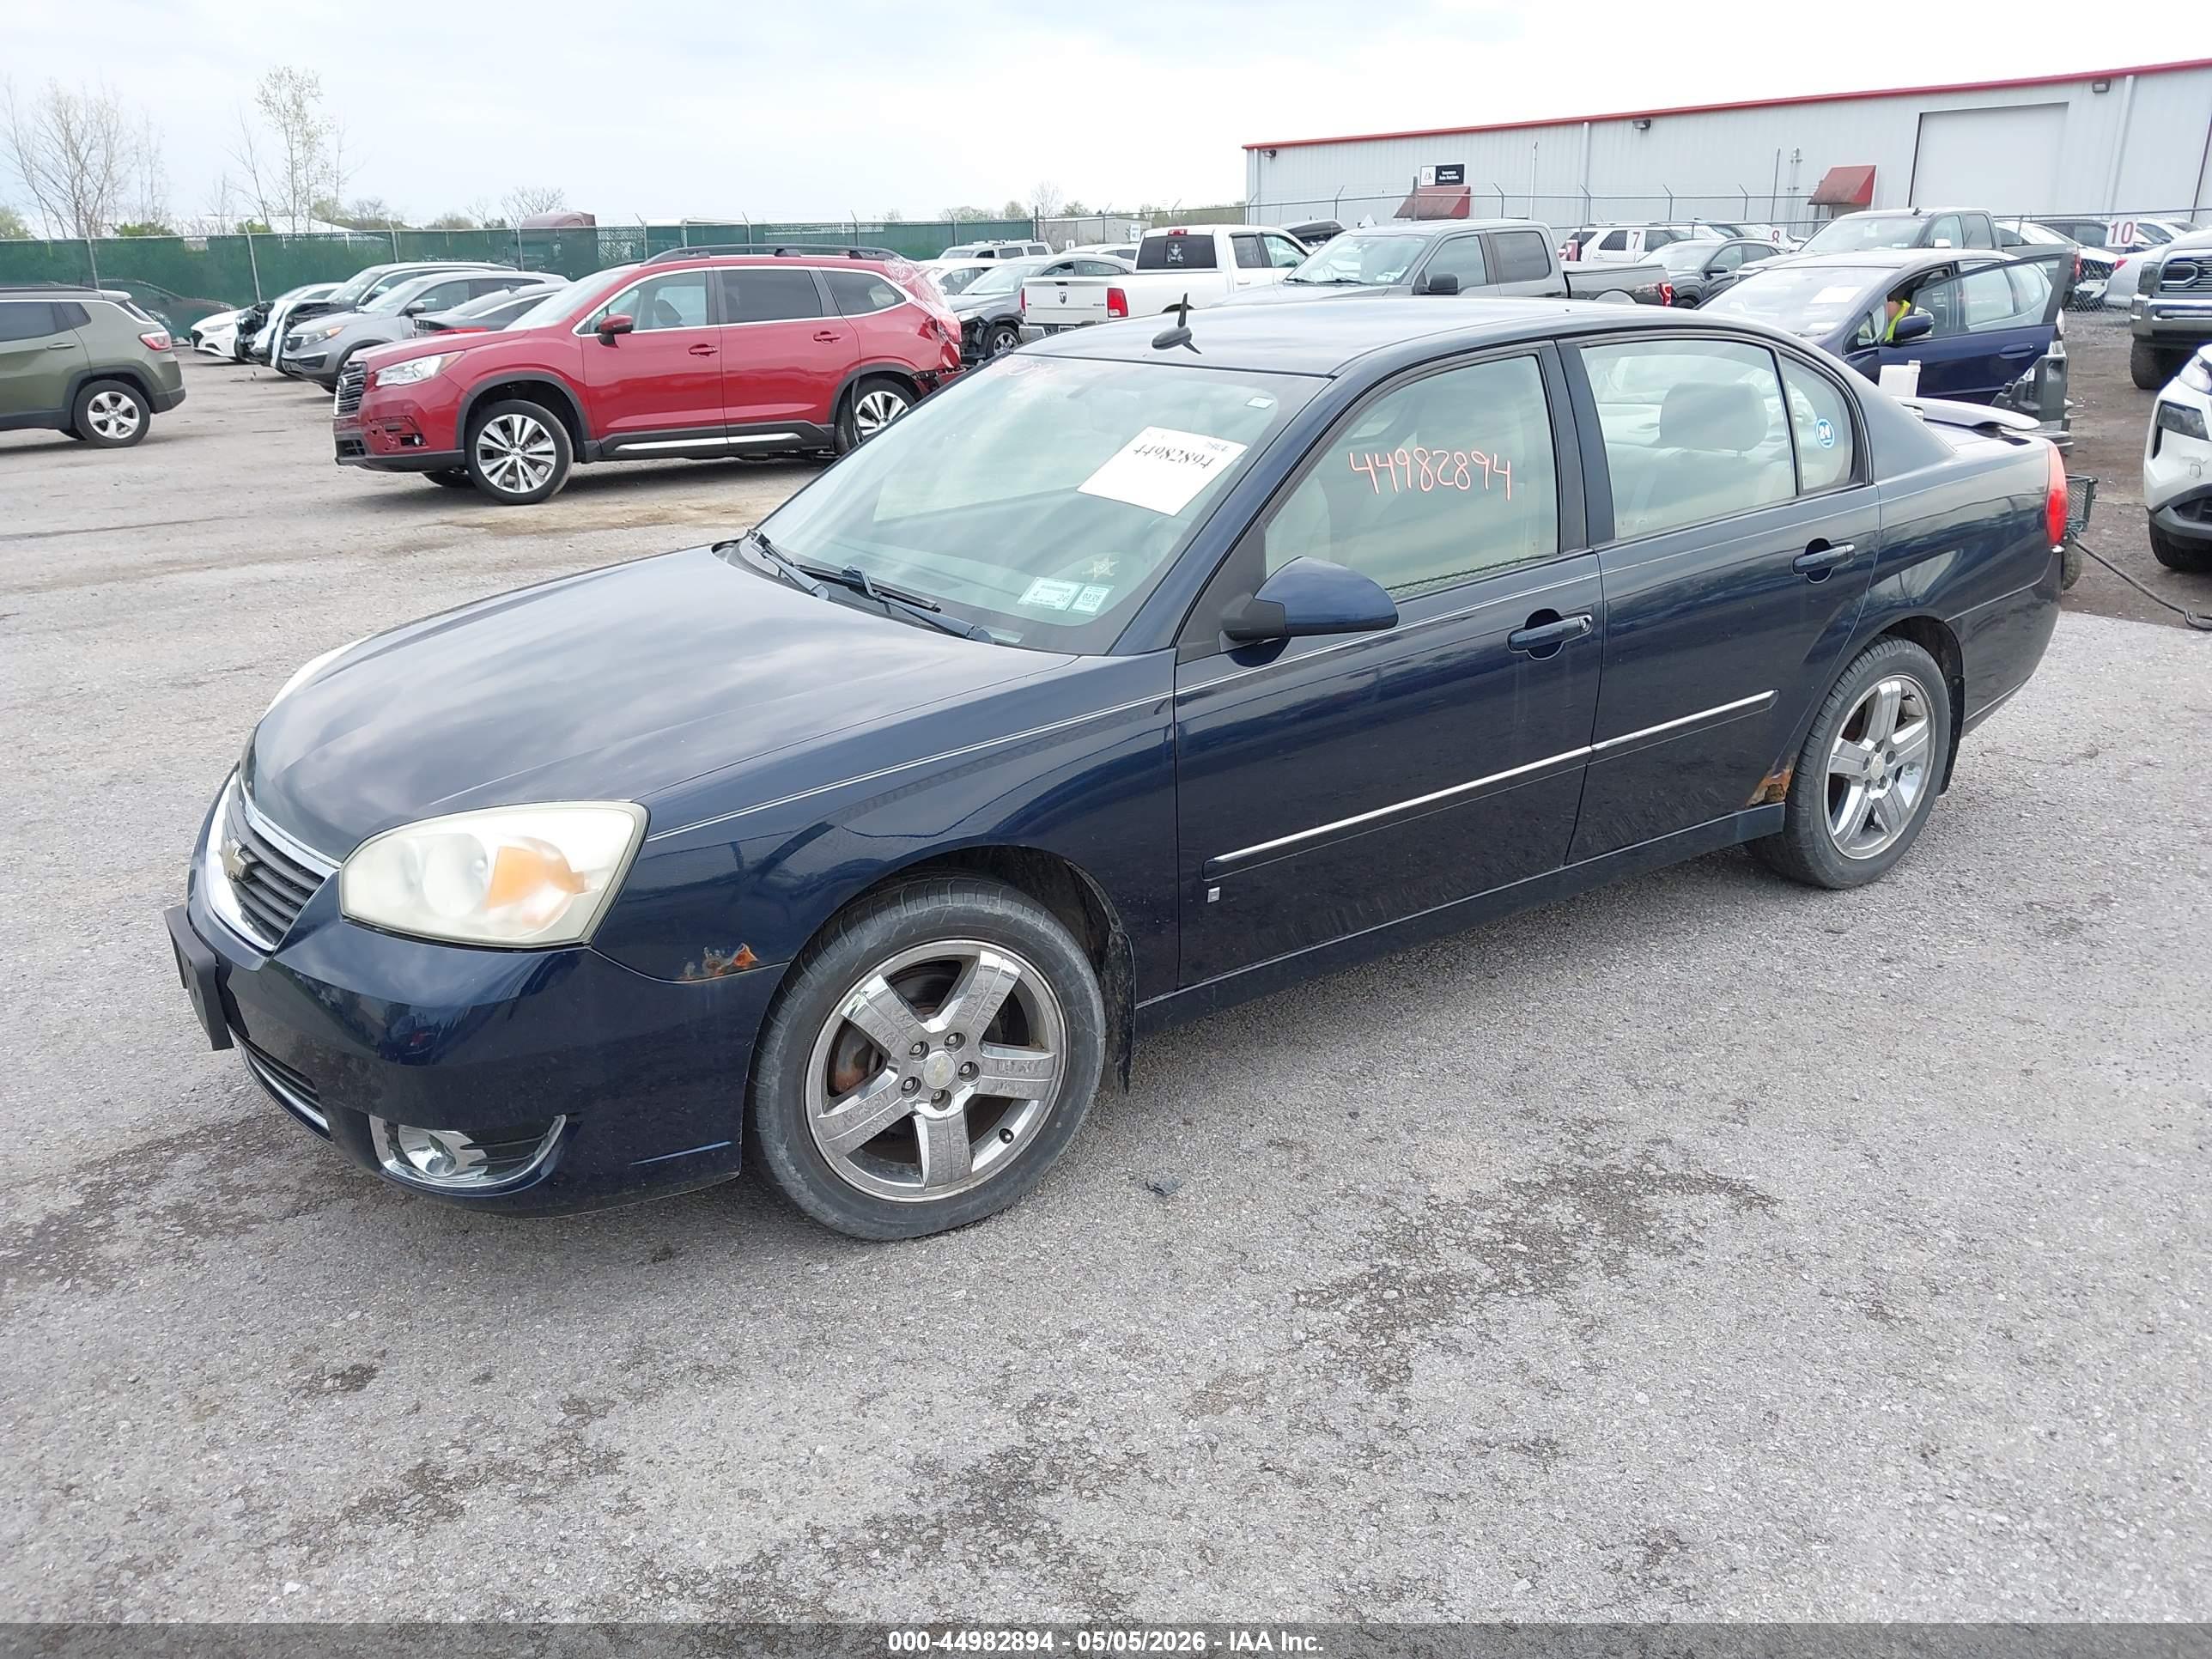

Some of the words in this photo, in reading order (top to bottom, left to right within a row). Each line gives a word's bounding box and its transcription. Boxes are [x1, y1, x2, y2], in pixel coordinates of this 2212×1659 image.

[1632, 231, 1641, 250] 7
[2111, 221, 2135, 245] 10
[1133, 443, 1216, 469] 44982894
[1348, 447, 1511, 501] 44982894
